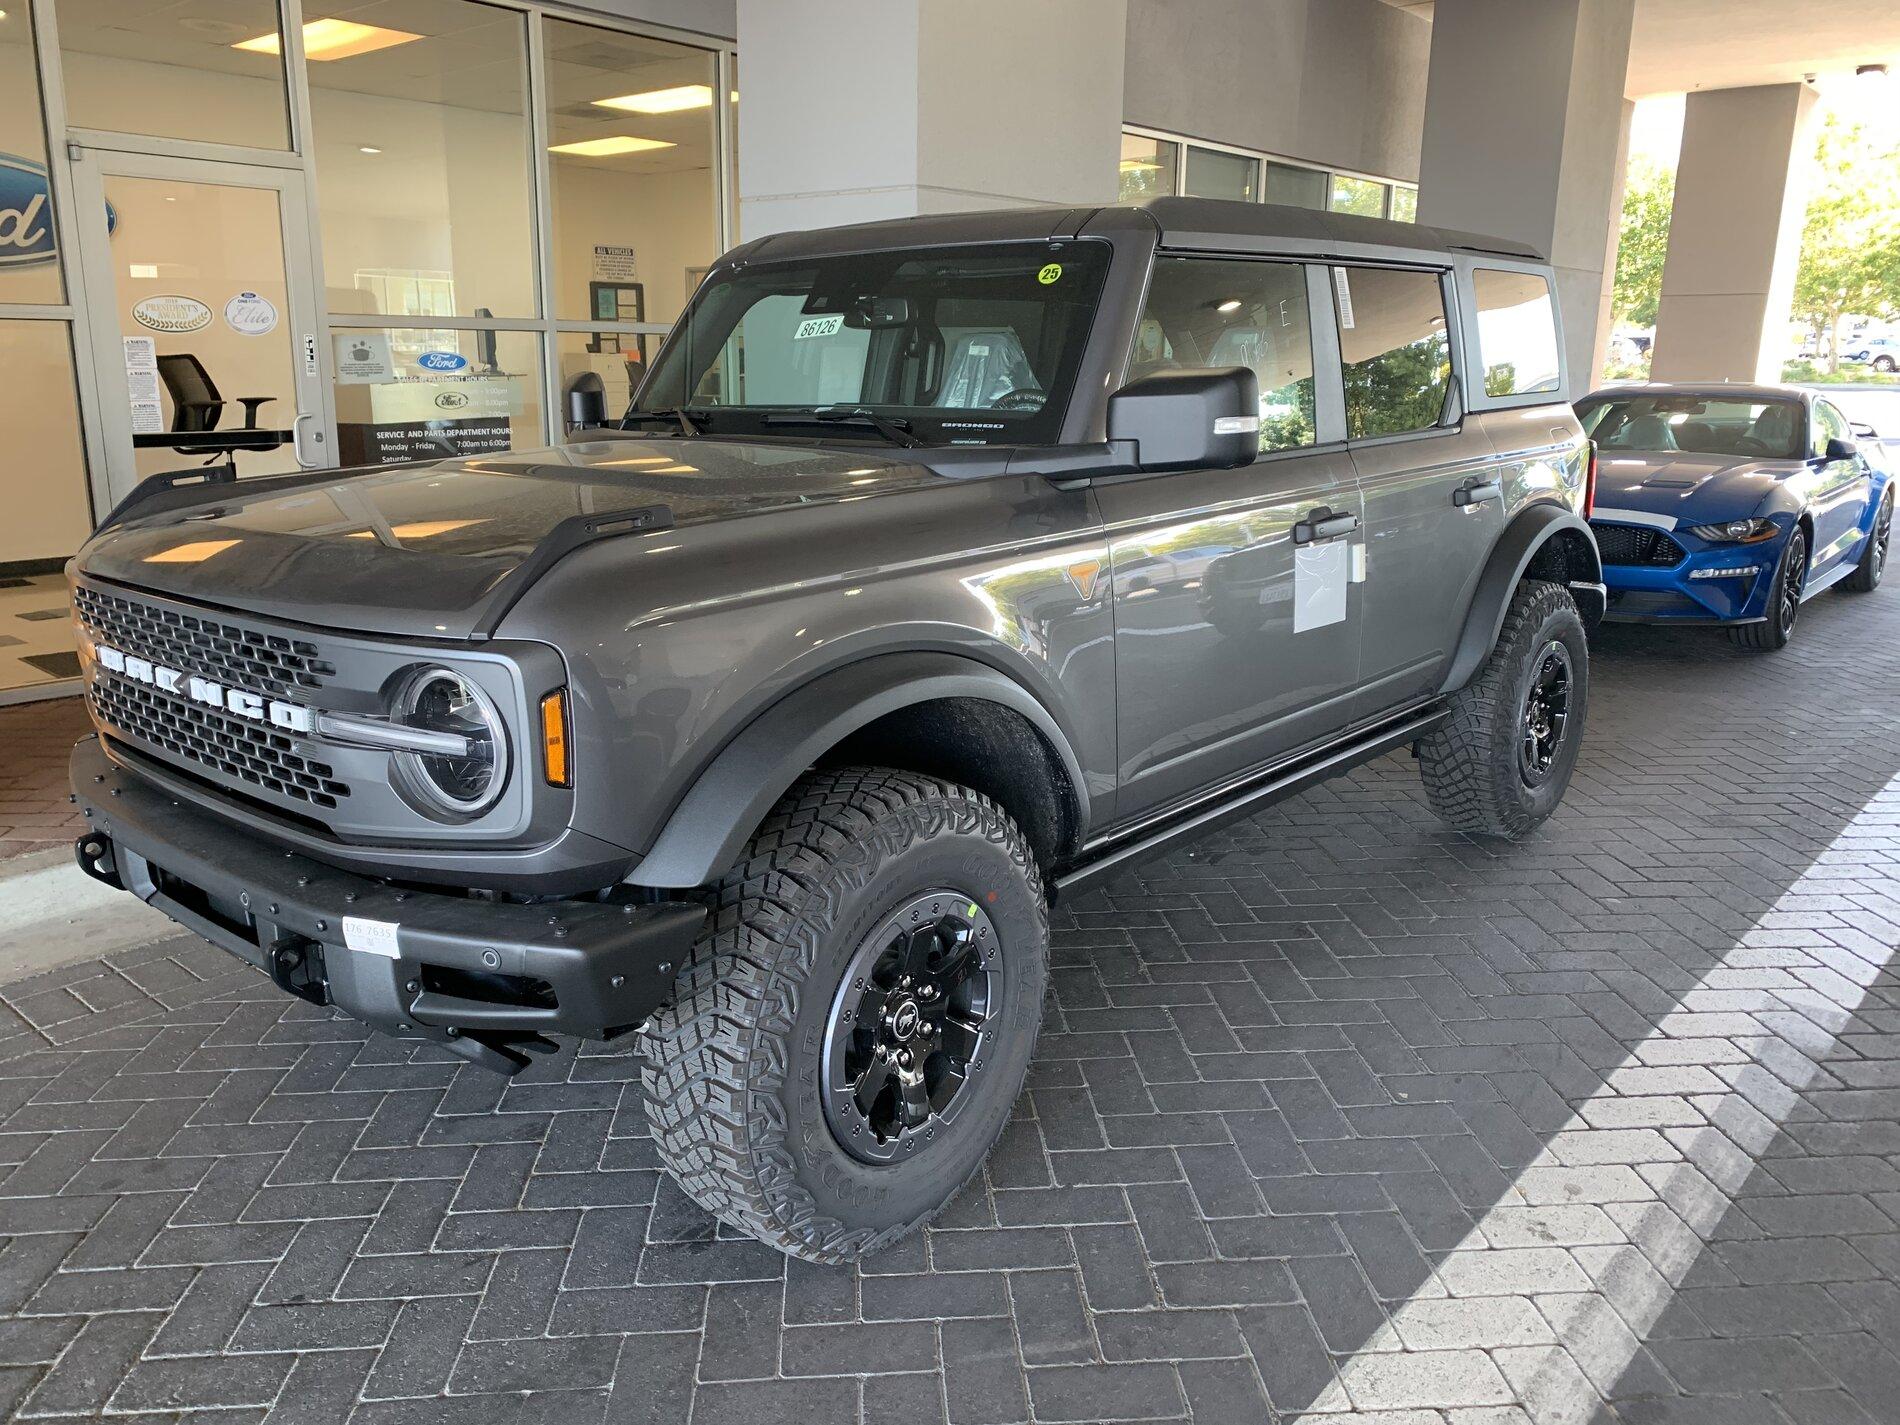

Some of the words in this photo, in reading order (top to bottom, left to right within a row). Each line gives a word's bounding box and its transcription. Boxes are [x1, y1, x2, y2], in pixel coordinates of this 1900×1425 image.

[1041, 267, 1060, 280] 25
[145, 303, 199, 313] PRESIDENT'S
[232, 304, 271, 324] Elite
[158, 310, 189, 320] AWARD
[800, 319, 838, 337] 86126
[427, 352, 458, 369] Ford
[376, 430, 405, 439] SERVICE
[408, 430, 423, 438] AND
[424, 429, 445, 437] PARTS
[446, 428, 491, 437] DEPARTMENT
[491, 427, 514, 435] HOURS
[380, 443, 409, 452] Monday
[415, 442, 436, 450] Friday
[456, 440, 480, 448] 7:00am
[481, 439, 489, 447] to
[489, 438, 512, 447] 6:00pm
[381, 454, 412, 464] Saturday
[98, 645, 310, 733] BRONCO
